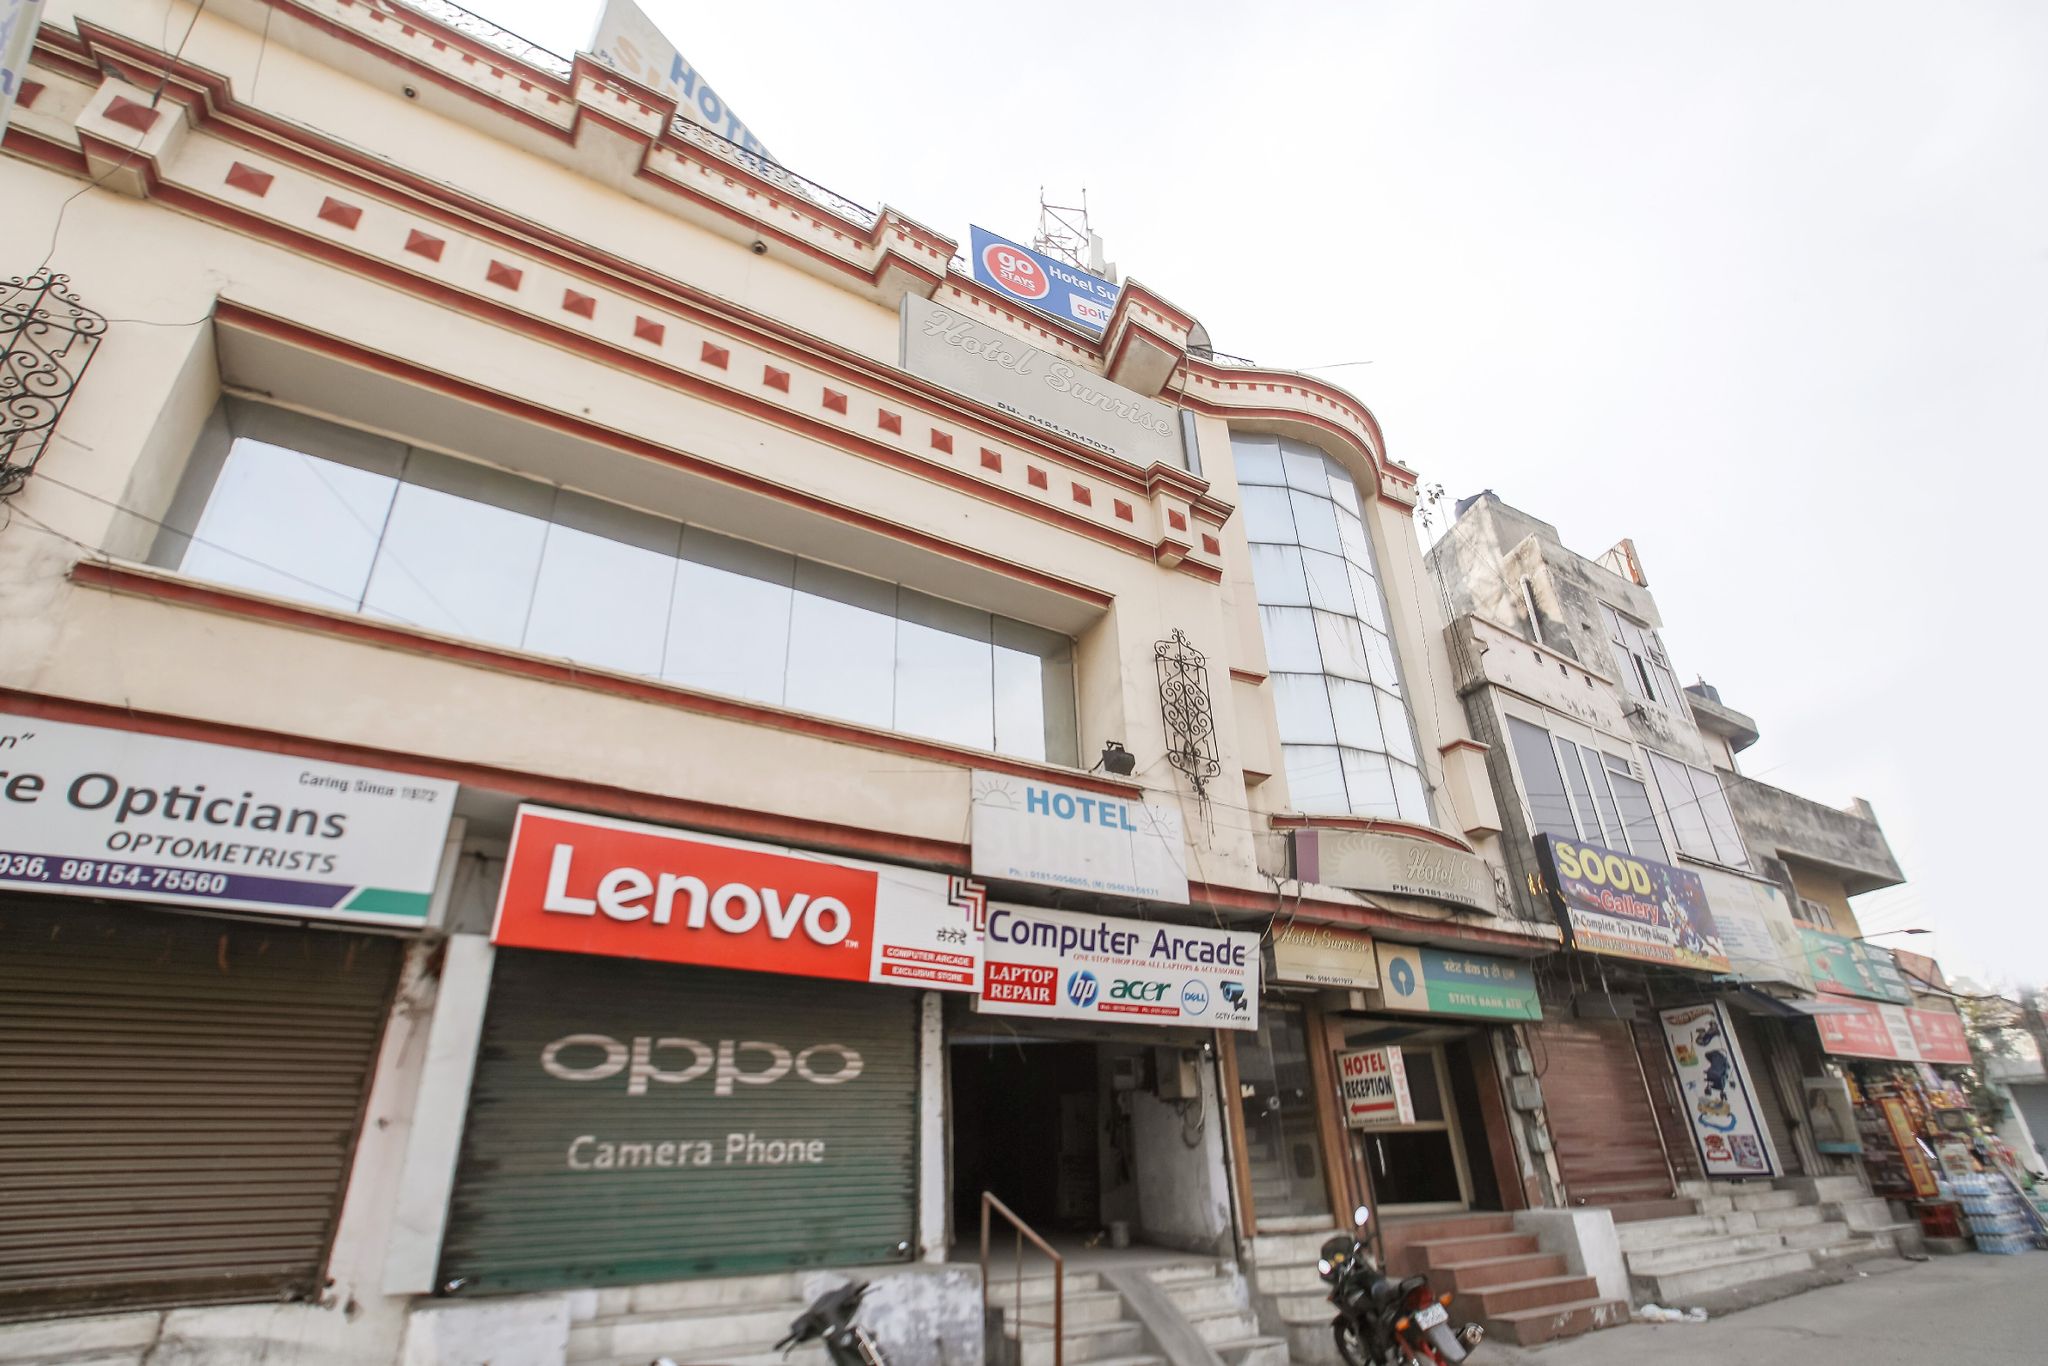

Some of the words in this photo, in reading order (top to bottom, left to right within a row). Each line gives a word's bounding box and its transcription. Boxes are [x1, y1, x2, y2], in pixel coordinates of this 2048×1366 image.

[998, 252, 1034, 275] go
[1000, 267, 1035, 289] STAYS
[1049, 265, 1094, 293] Hotel
[921, 309, 1033, 376] Hotel
[1043, 361, 1173, 438] Sunrise
[298, 771, 350, 793] Caring
[354, 779, 394, 797] Since
[66, 771, 347, 840] Opticians
[1026, 786, 1138, 832] HOTEL
[106, 831, 339, 874] OPTOMETRISTS
[60, 859, 228, 895] 98154-75560
[1407, 847, 1456, 887] Hotel
[1555, 842, 1652, 896] SOOD
[543, 843, 851, 946] Lenovo
[1600, 889, 1659, 926] Gallery
[1580, 913, 1615, 932] Complete
[989, 910, 1140, 957] Computer
[1150, 929, 1246, 967] Arcade
[1281, 924, 1317, 946] Hotel
[1321, 930, 1370, 952] Sunrise
[886, 947, 935, 962] COMPUTER
[935, 954, 970, 965] ARCADE
[1073, 953, 1090, 962] ONE
[1091, 955, 1110, 964] STOP
[1111, 956, 1130, 966] SHOP
[1131, 959, 1147, 967] FOR
[1148, 961, 1162, 969] ALL
[1163, 962, 1193, 972] LAPTOPS
[1200, 966, 1245, 976] ACCESSORIES
[891, 965, 936, 979] EXCLUSIVE
[989, 965, 1055, 984] LAPTOP
[991, 982, 1051, 1002] REPAIR
[1070, 970, 1096, 1008] hp
[1110, 979, 1172, 1002] acer
[1448, 992, 1477, 1006] STATE
[1215, 1013, 1230, 1021] CCTV
[1343, 1052, 1386, 1076] HOTEL
[1345, 1075, 1393, 1099] RECEPTION
[567, 1135, 713, 1170] Camera
[725, 1132, 826, 1165] Phone
